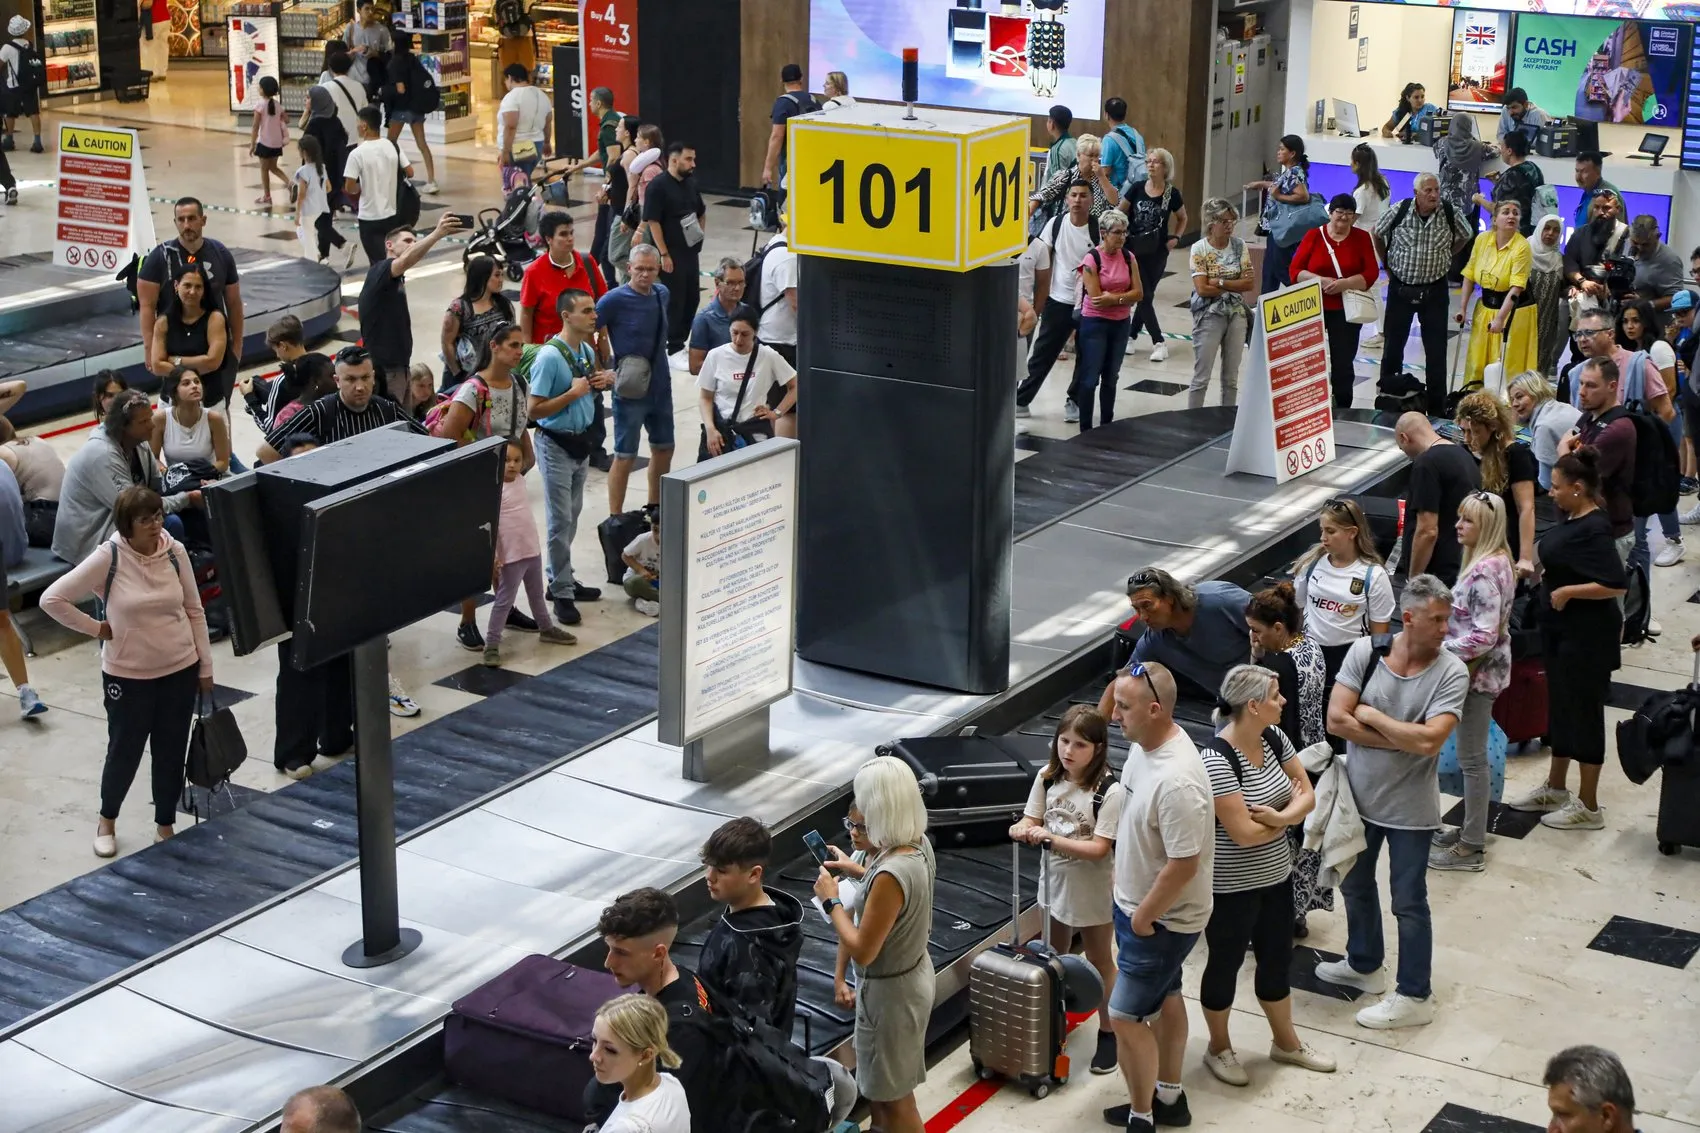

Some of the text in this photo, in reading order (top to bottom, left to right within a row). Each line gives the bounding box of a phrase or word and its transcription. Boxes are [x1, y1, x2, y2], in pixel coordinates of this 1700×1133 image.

[591, 3, 616, 25] Buy 4
[605, 24, 630, 46] Pay 3
[1525, 37, 1576, 57] CASH
[84, 138, 127, 151] CAUTION
[819, 159, 931, 234] 101
[974, 156, 1022, 232] 101
[1283, 295, 1317, 318] CAUTION
[1309, 594, 1359, 618] HECK24
